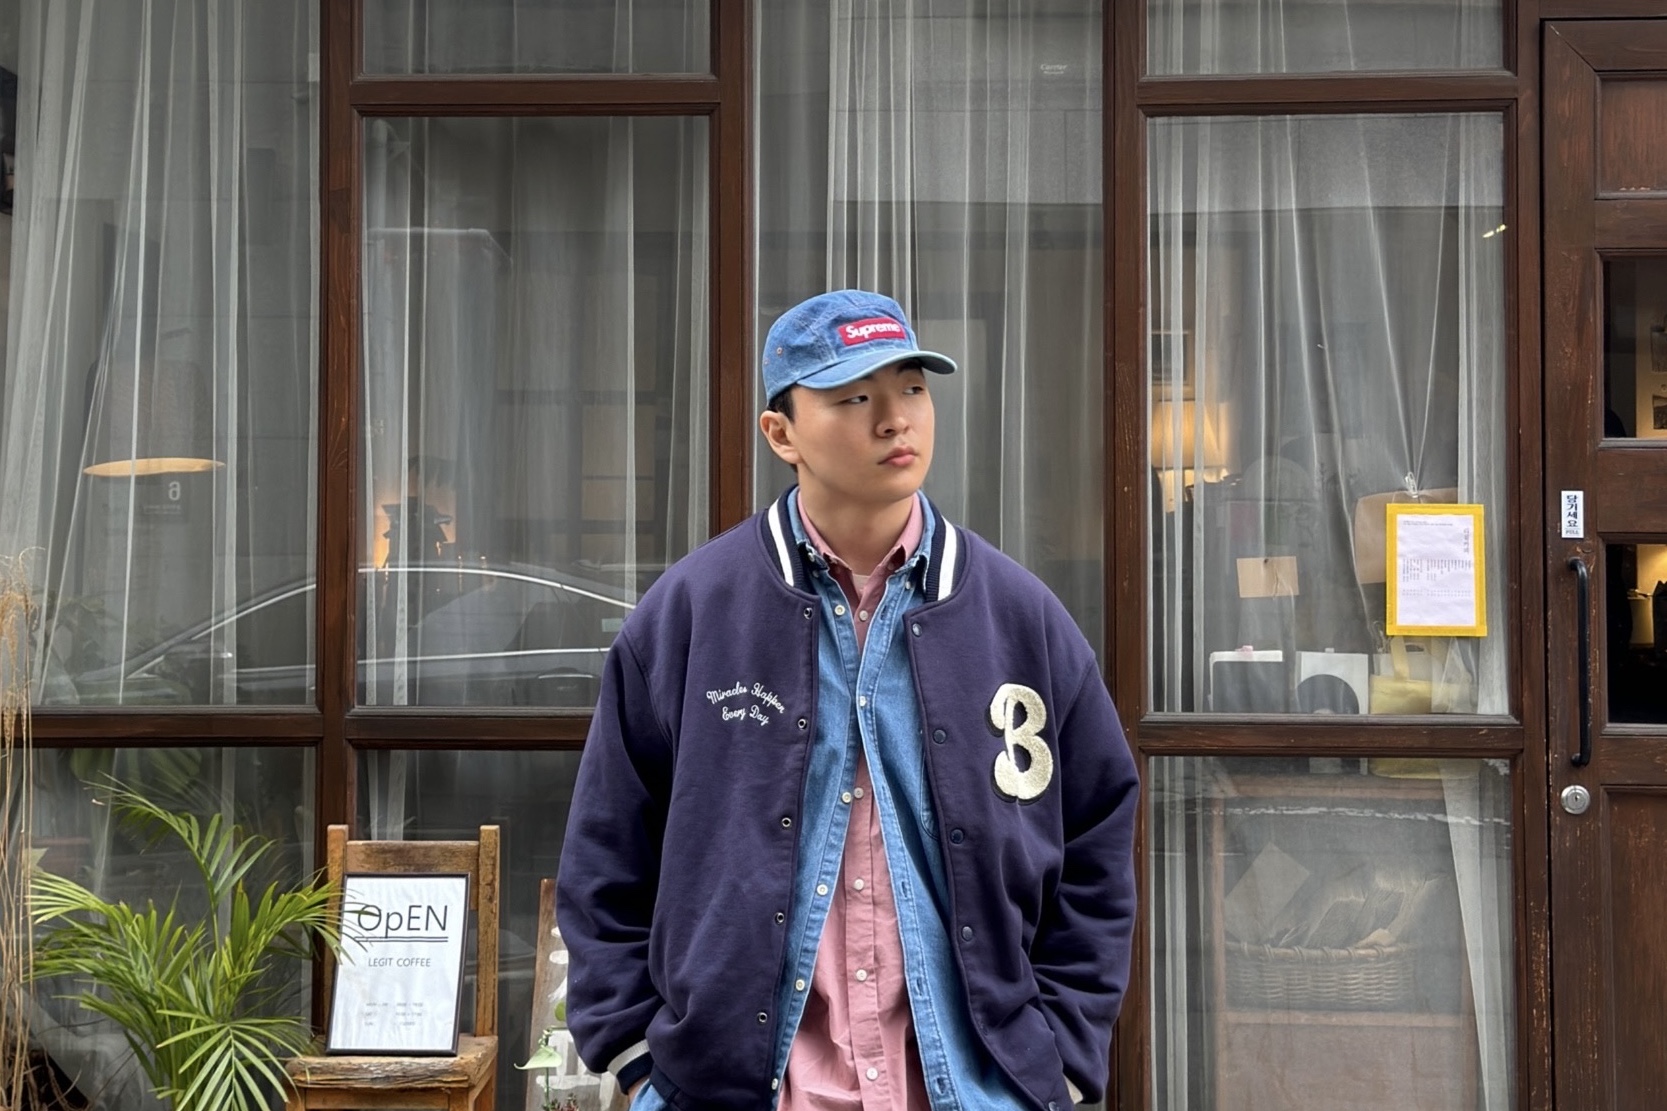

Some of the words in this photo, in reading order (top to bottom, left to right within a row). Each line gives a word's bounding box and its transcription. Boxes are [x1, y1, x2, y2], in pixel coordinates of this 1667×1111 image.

[845, 323, 901, 339] Supreme
[1566, 494, 1578, 528] 당기세요
[706, 681, 748, 705] Miracles
[751, 682, 785, 714] Happen
[722, 706, 746, 721] Every
[749, 704, 769, 726] Day
[368, 957, 394, 968] LEGIT
[396, 957, 432, 968] COFFEE
